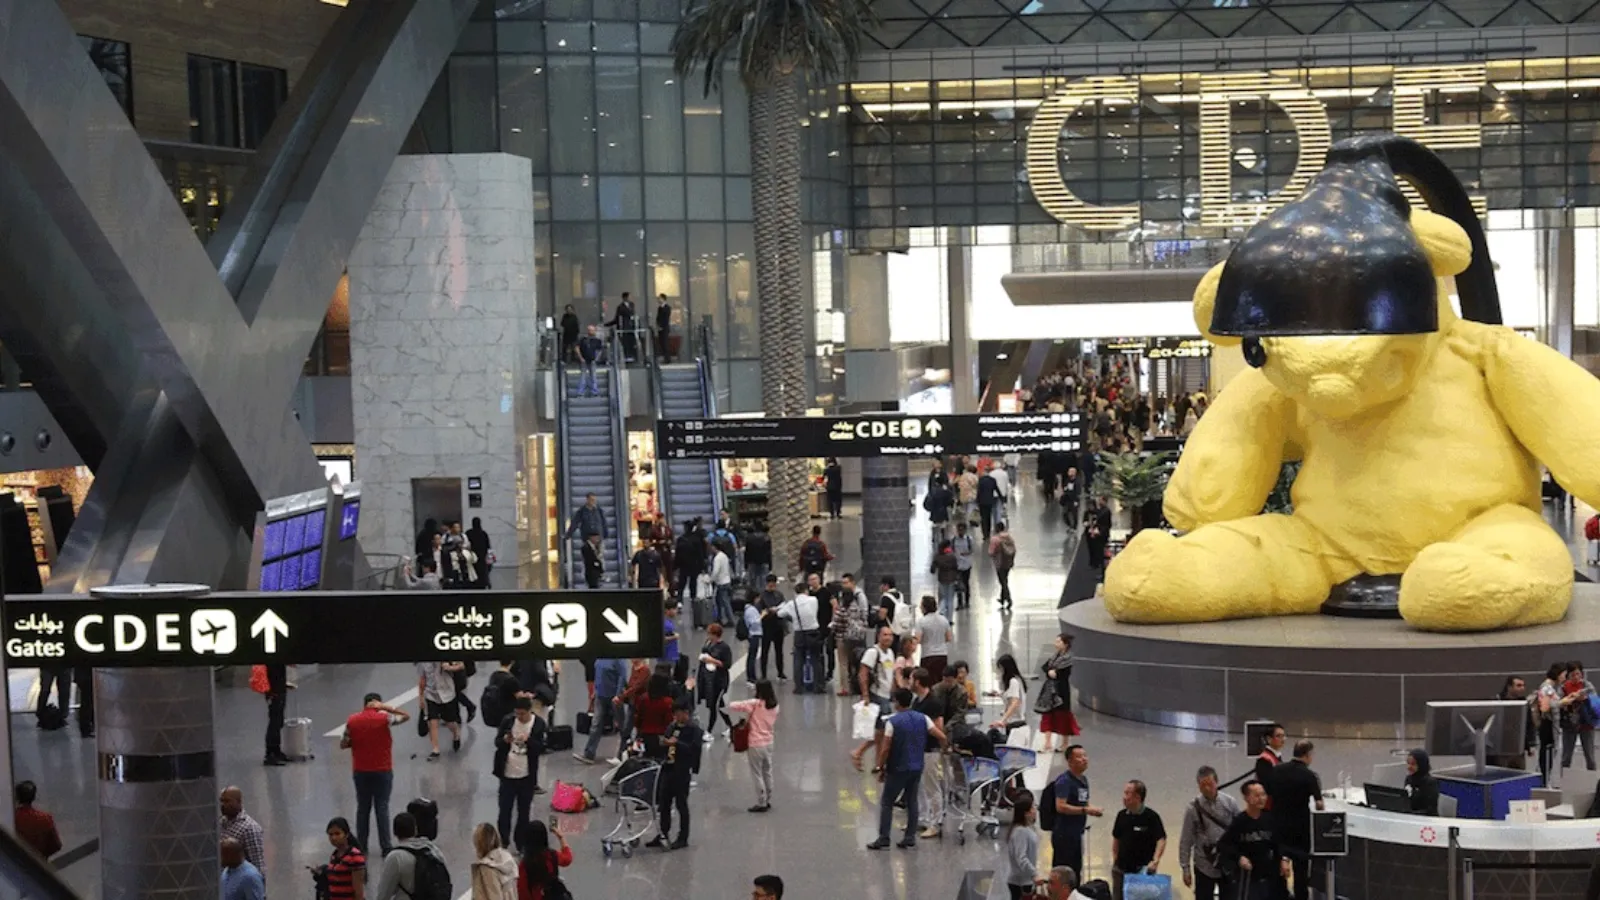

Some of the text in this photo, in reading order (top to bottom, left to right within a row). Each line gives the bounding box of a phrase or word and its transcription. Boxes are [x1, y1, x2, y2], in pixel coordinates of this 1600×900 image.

[856, 421, 899, 438] CDE
[14, 612, 64, 635] بوابات
[442, 606, 493, 627] بوابات
[503, 607, 531, 645] B
[74, 613, 182, 653] CDE
[433, 632, 493, 651] Gates
[6, 638, 65, 658] Gates
